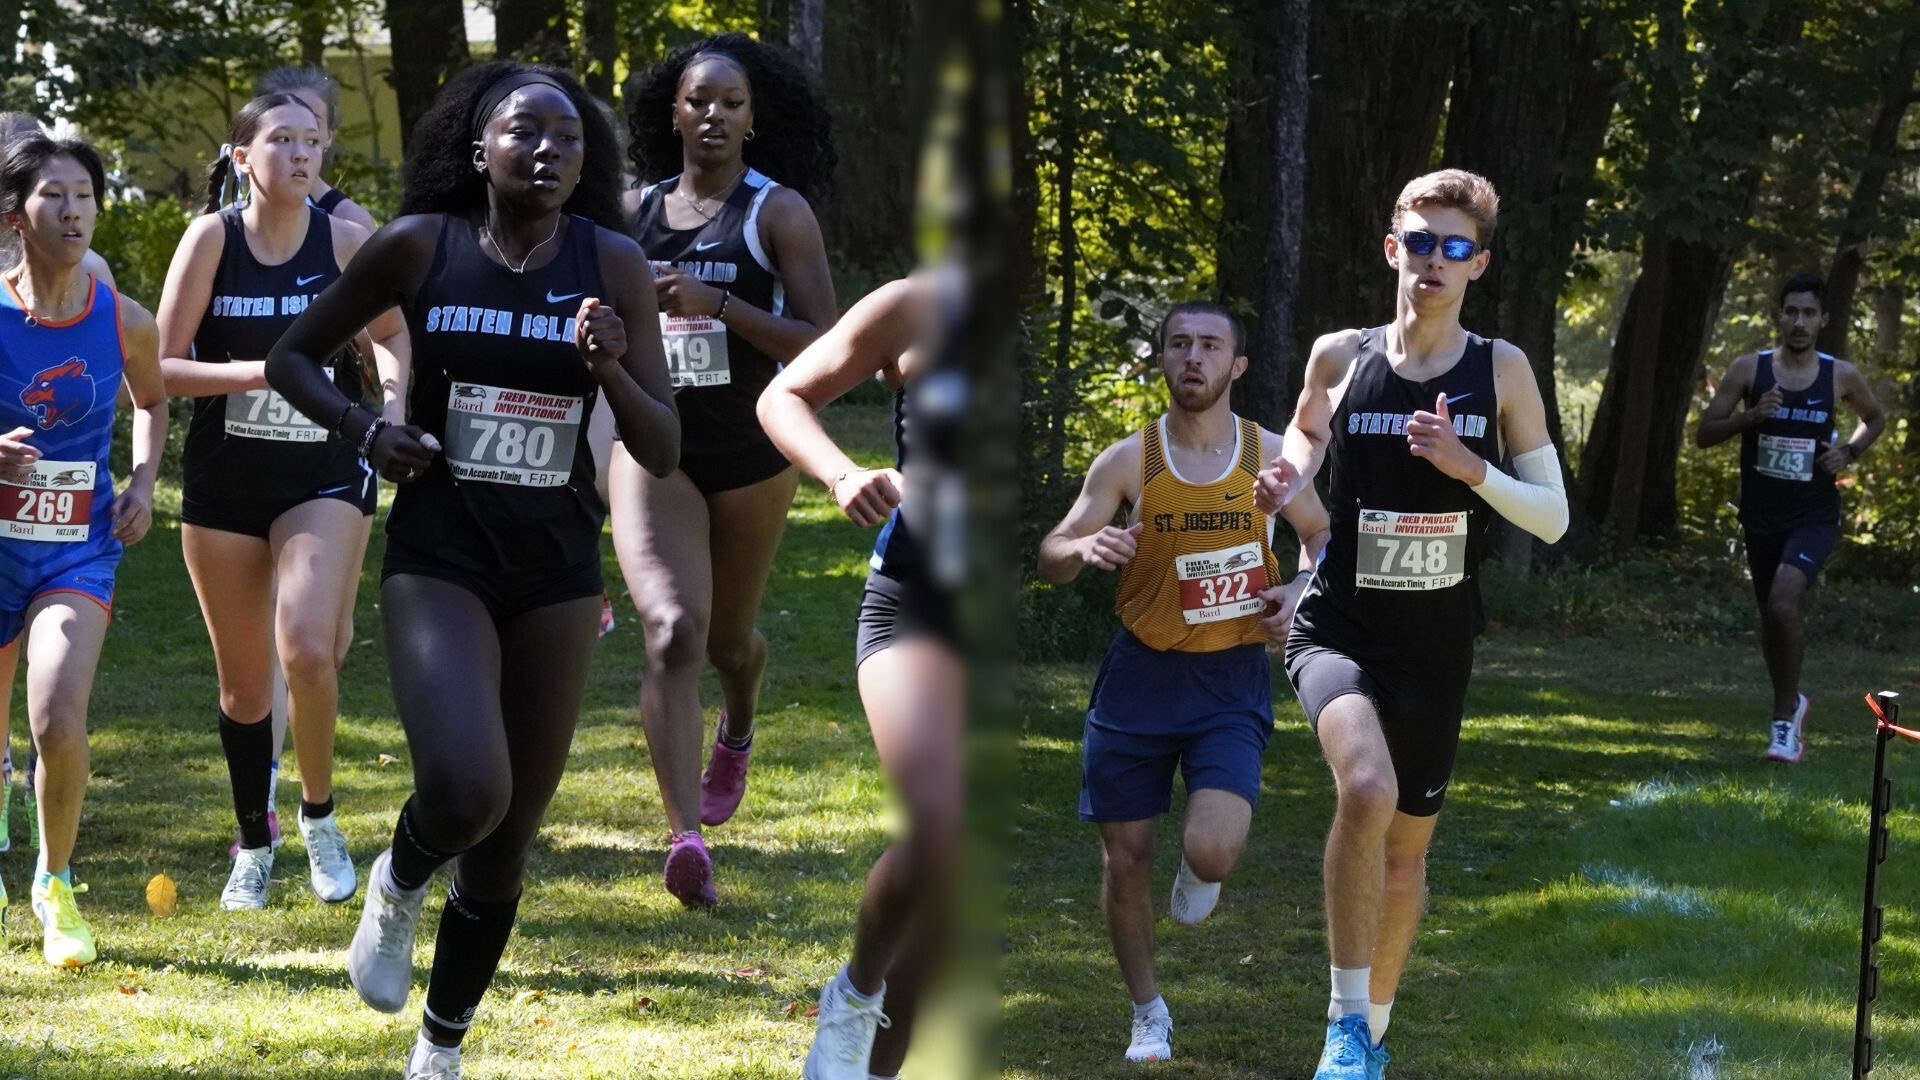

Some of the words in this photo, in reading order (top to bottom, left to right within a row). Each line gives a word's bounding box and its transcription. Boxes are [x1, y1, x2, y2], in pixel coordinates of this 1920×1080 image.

[213, 295, 275, 316] STATEN
[281, 294, 319, 315] ISL
[426, 305, 513, 335] STATEN
[453, 399, 483, 413] Bard
[498, 391, 526, 404] FRED
[527, 393, 574, 409] PAVLICH
[493, 402, 567, 420] INVITATIONAL
[231, 424, 247, 434] Fulton
[247, 427, 271, 437] Accurate
[272, 429, 290, 440] Timing
[470, 418, 555, 468] 780
[1767, 450, 1805, 472] 743
[467, 468, 499, 480] Accurate
[499, 471, 522, 484] Timing
[16, 489, 74, 524] 269
[1154, 513, 1176, 533] ST.
[1180, 511, 1252, 532] JOSEPH'S
[1362, 523, 1386, 533] Bard
[1397, 515, 1420, 524] FRED
[1421, 515, 1459, 525] PAVLICH
[9, 523, 35, 535] Bard
[1394, 524, 1455, 534] INVITATIONAL
[1377, 538, 1448, 574] 748
[1186, 562, 1220, 572] PAVLICH
[1186, 568, 1222, 579] INVITATIONAL
[1199, 572, 1251, 606] 322
[1363, 577, 1380, 586] Fulton
[1380, 578, 1406, 588] Accurate
[1407, 580, 1426, 590] Timing
[1200, 608, 1220, 619] Bard
